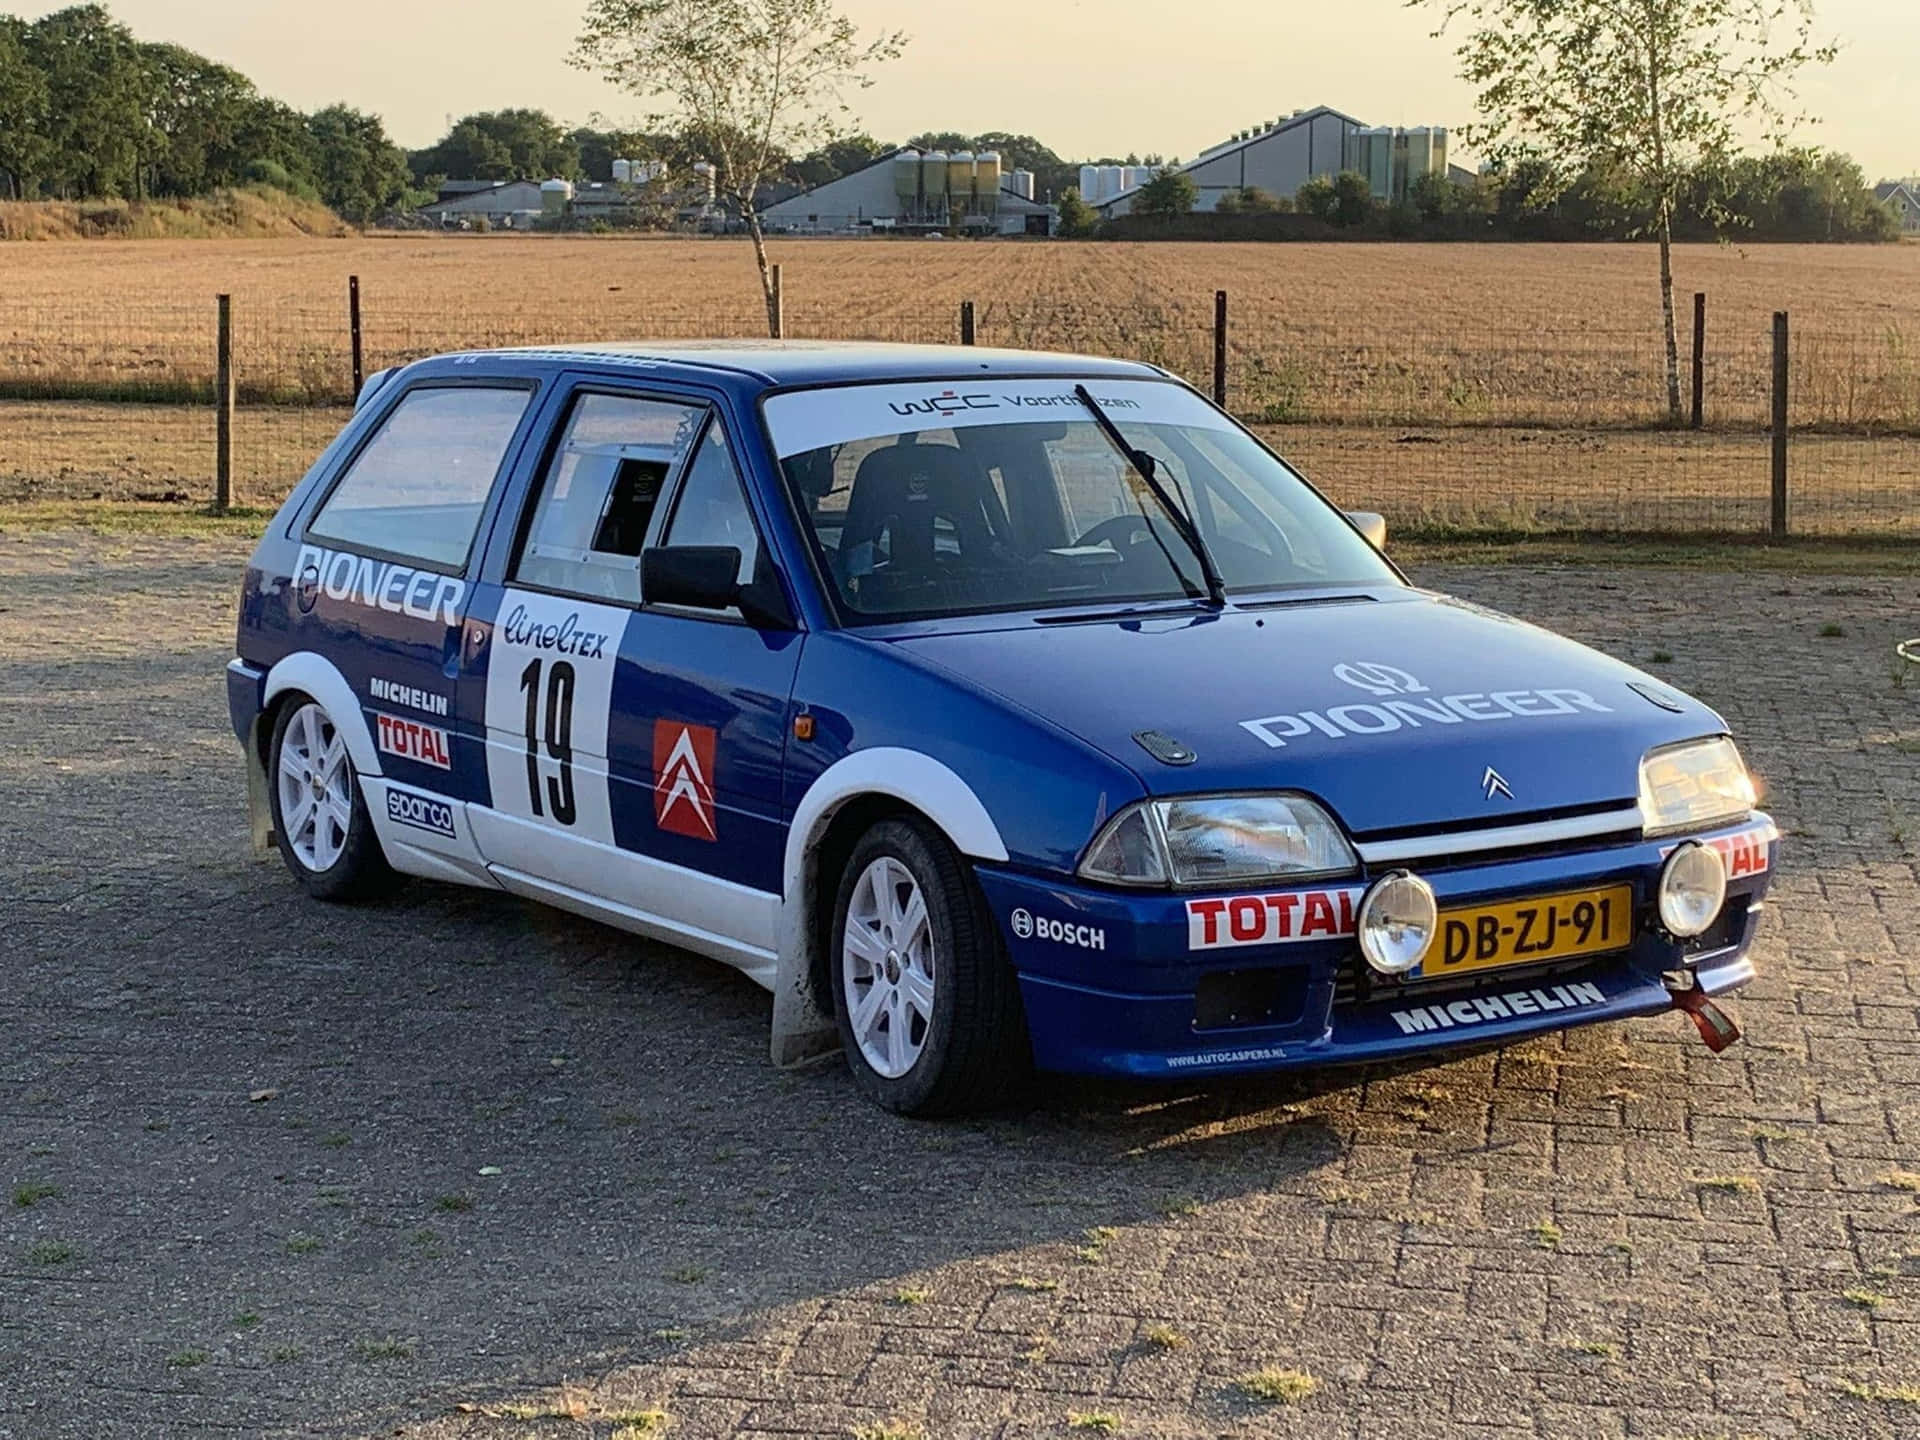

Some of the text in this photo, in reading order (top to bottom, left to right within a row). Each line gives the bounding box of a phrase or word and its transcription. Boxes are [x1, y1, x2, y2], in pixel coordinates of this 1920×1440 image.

[1002, 393, 1141, 409] Voorthizen
[291, 543, 466, 628] PIONEER
[370, 677, 448, 717] MICHELIN
[1238, 688, 1615, 748] PIONEER
[379, 716, 449, 766] TOTAL
[519, 657, 576, 826] 19
[387, 790, 453, 831] sparco
[1036, 917, 1105, 951] BOSCH
[1443, 897, 1612, 966] DB-ZJ-91
[1390, 981, 1606, 1035] MICHELIN
[1166, 1048, 1287, 1068] WWW.AUTOCASPERS.NL
